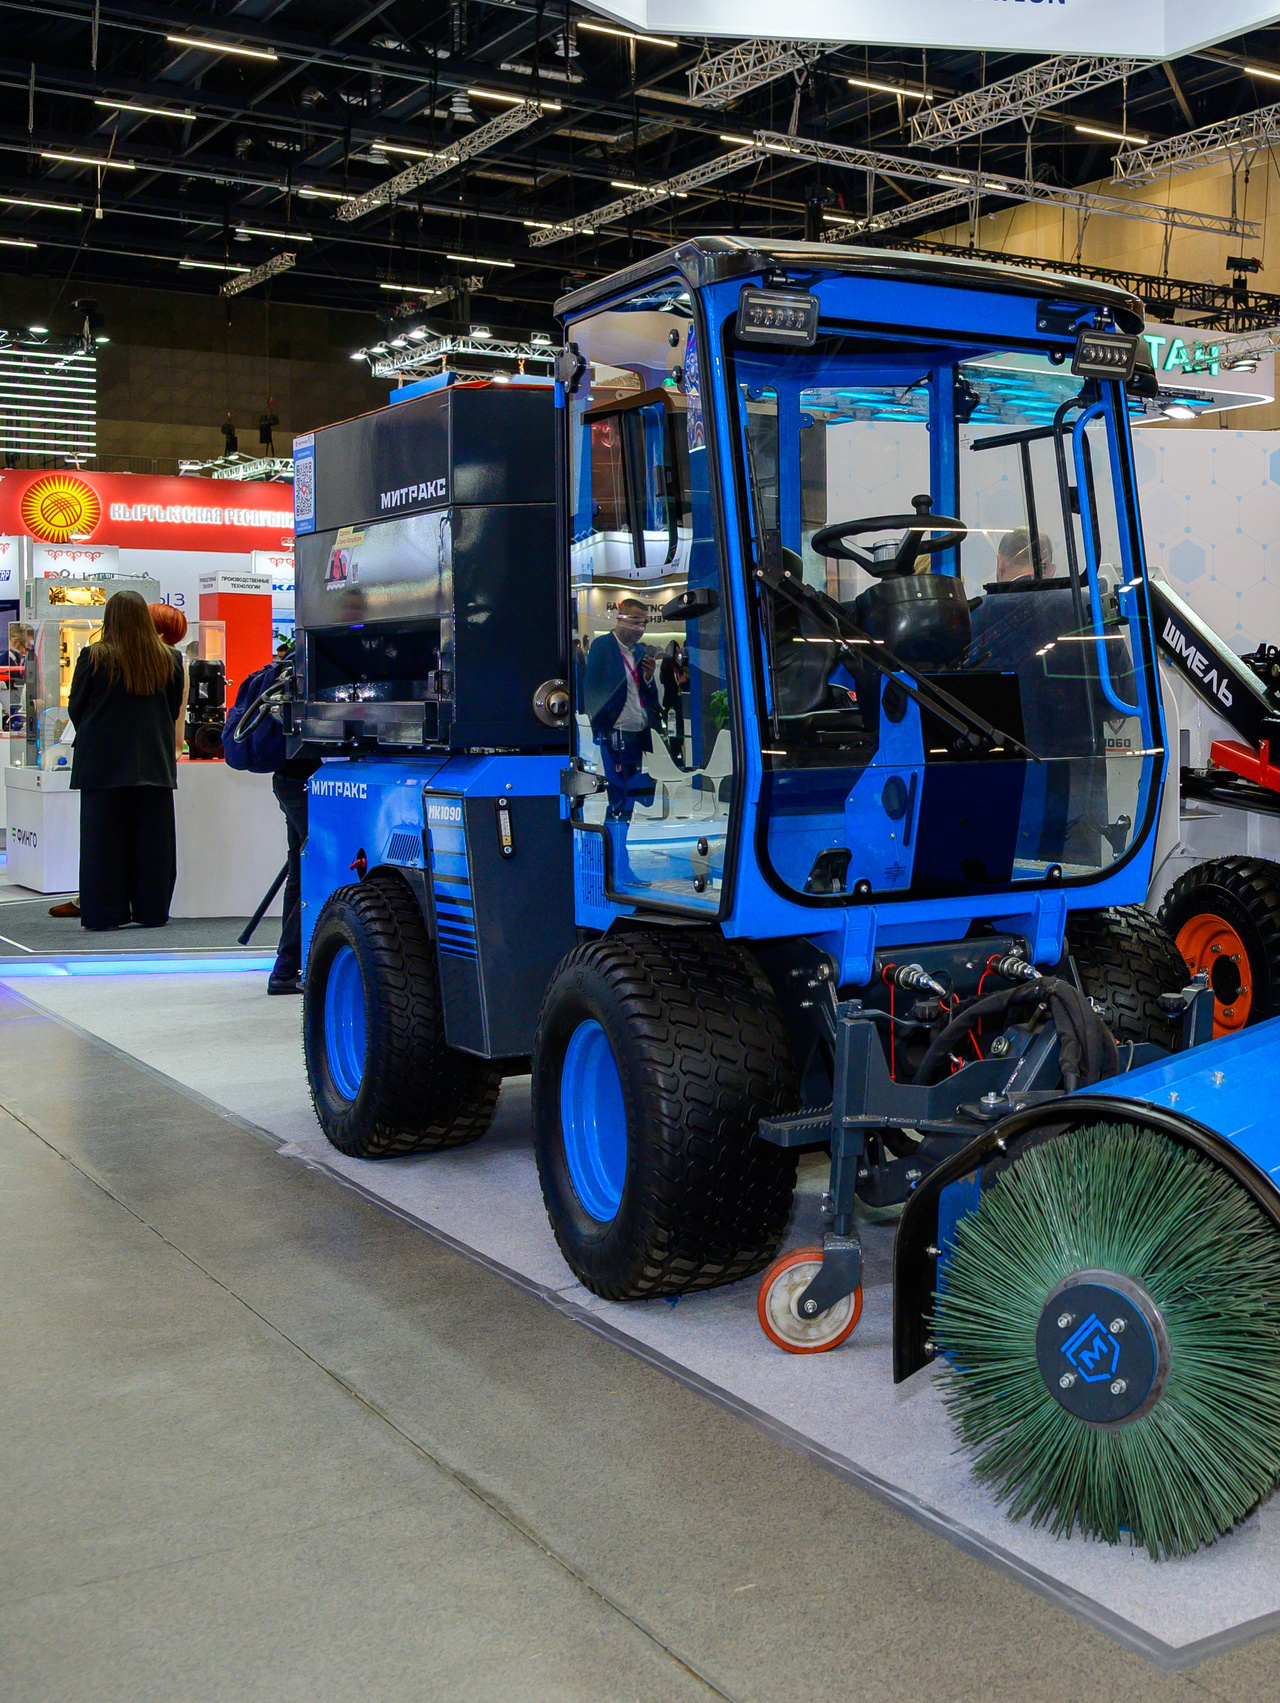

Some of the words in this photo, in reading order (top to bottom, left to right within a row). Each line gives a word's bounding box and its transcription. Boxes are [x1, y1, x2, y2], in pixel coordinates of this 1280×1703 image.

[380, 478, 446, 510] МИТРАКС
[110, 503, 223, 525] КЫРГЫЗСКАЯ
[1162, 617, 1233, 708] ШМЕЛЬ
[311, 780, 368, 800] МИТРАКС
[17, 828, 38, 849] ФИНГО
